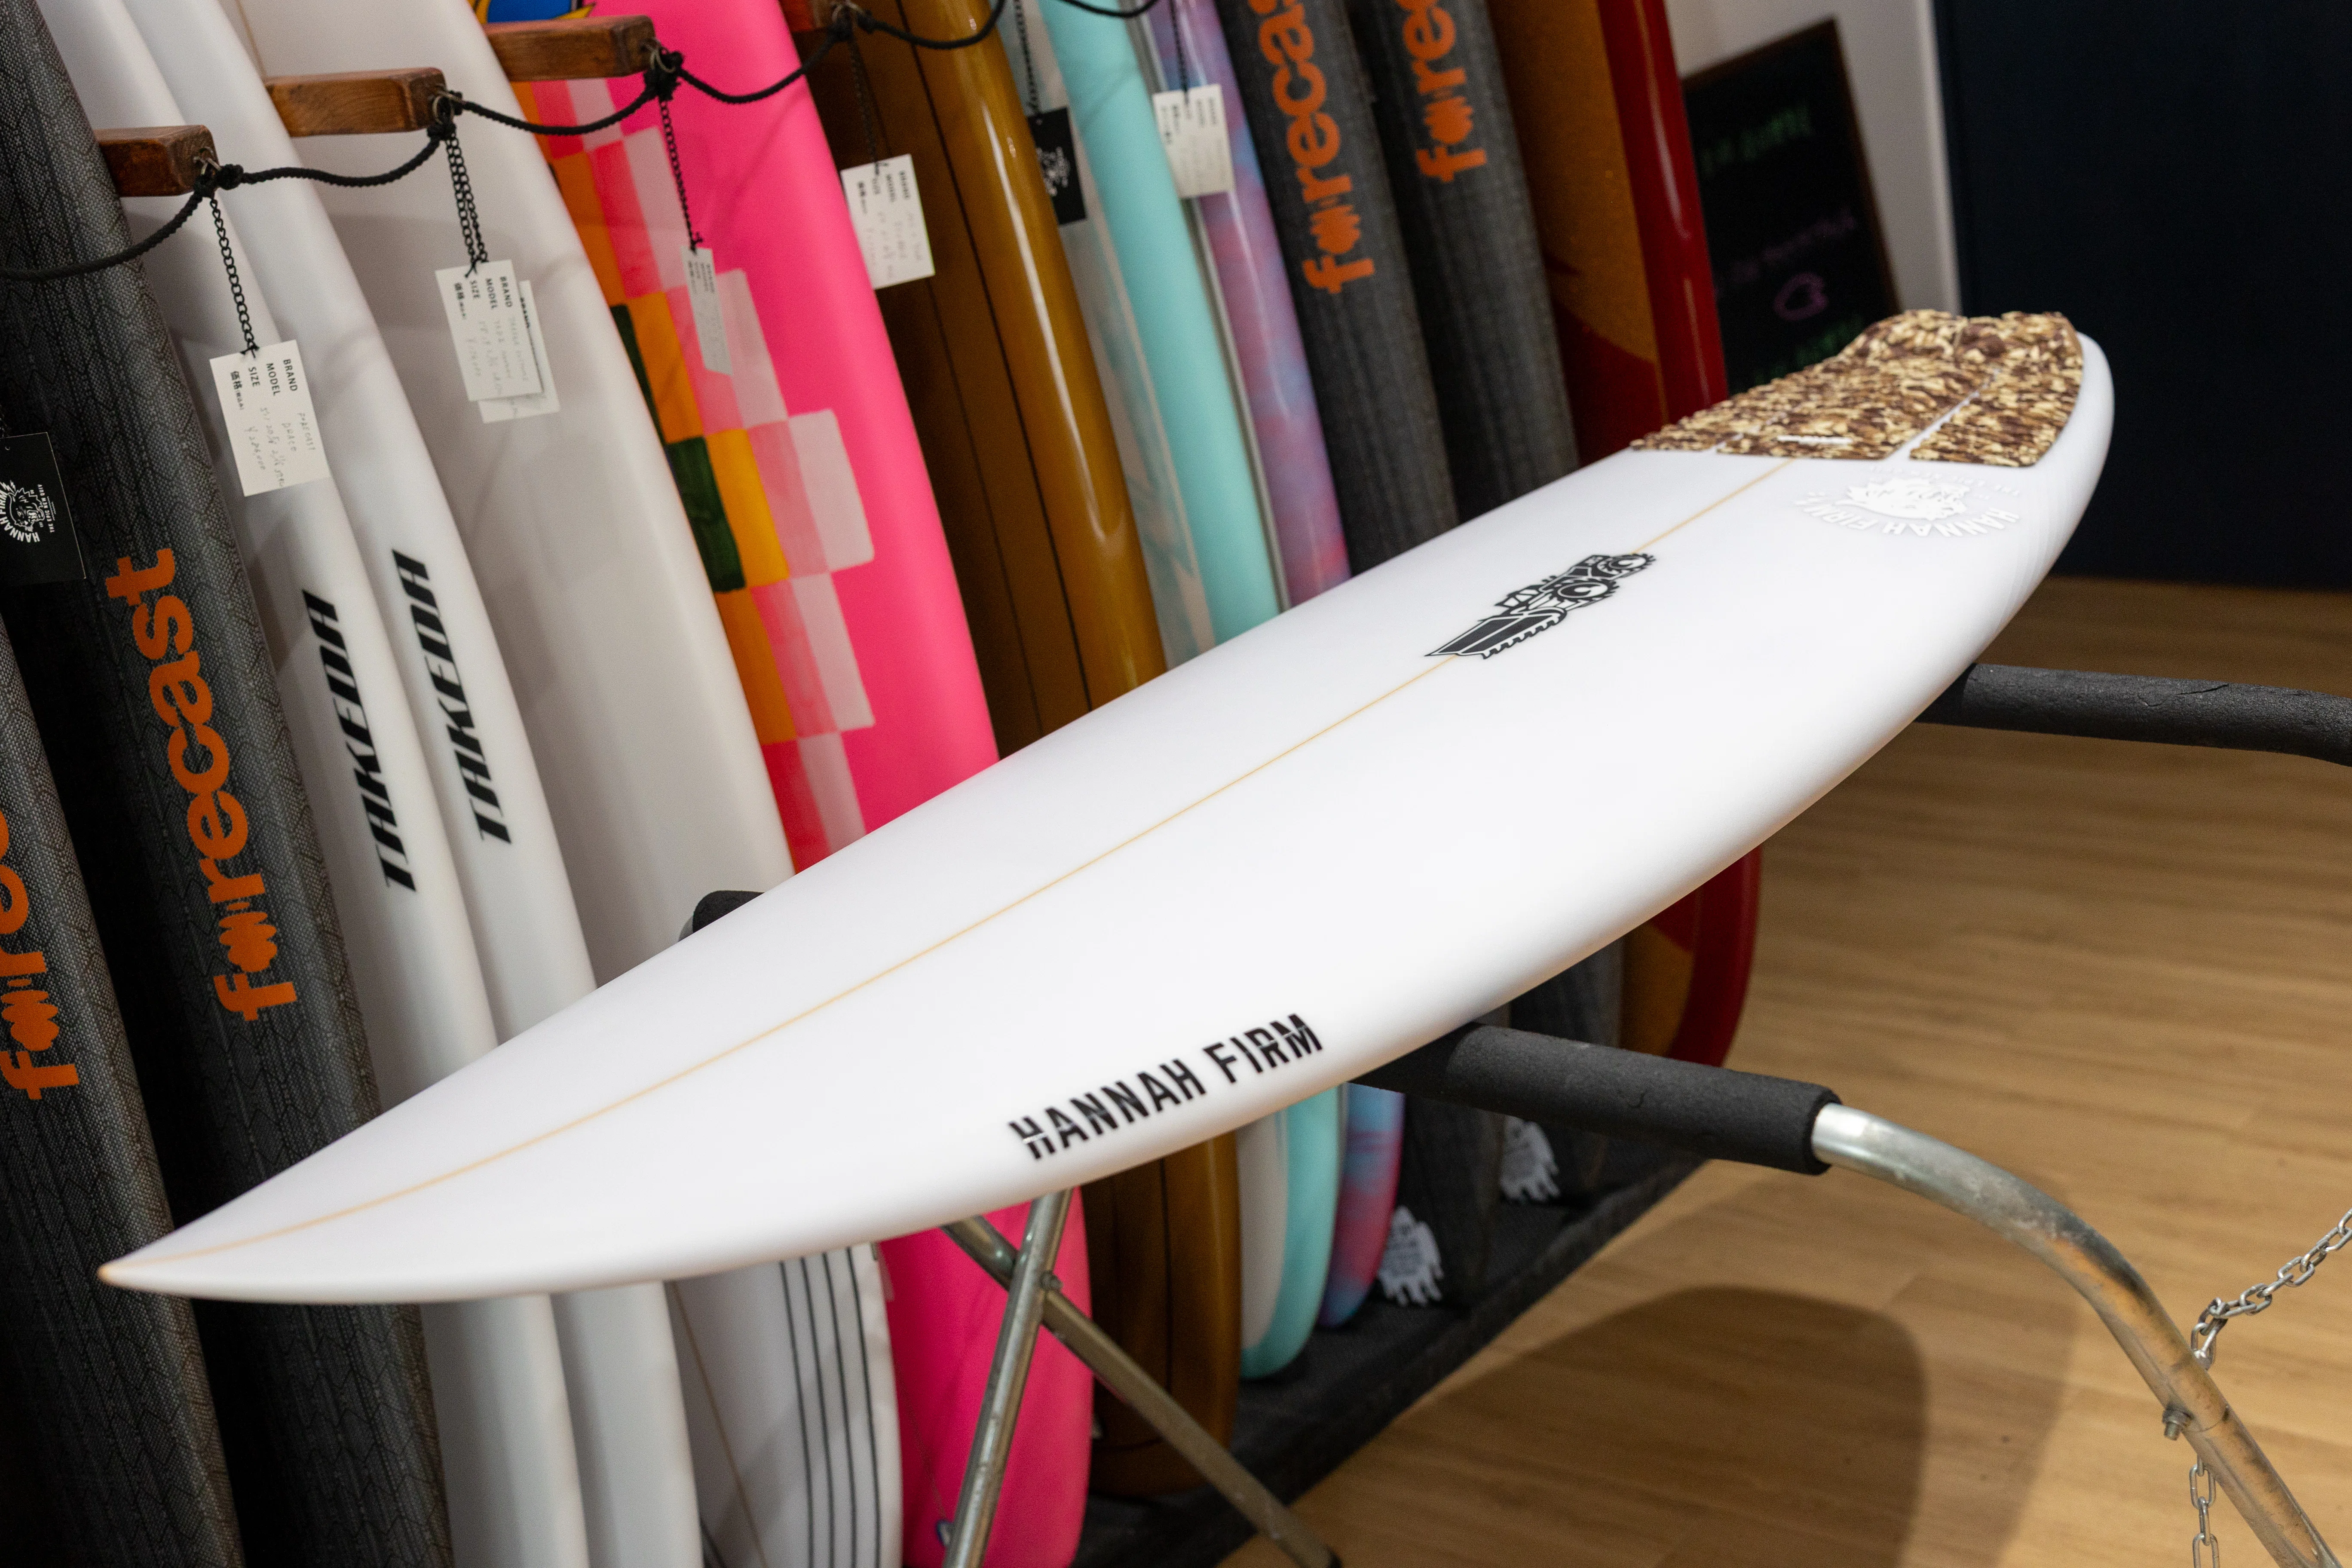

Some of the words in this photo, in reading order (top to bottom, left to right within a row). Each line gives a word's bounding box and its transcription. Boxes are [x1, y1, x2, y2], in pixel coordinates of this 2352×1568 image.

[470, 280, 480, 299] SIZE
[486, 278, 498, 309] MODEL
[500, 276, 513, 308] BRAND
[248, 366, 260, 387] SIZE
[266, 362, 281, 397] MODEL
[283, 358, 298, 392] BRAND
[0, 517, 40, 542] HANNAH
[1882, 507, 2020, 537] HANNAH
[392, 549, 512, 844] TAKEDA
[302, 589, 416, 892] TAKEDA
[1008, 1059, 1207, 1160] HANNAH
[1203, 1013, 1323, 1084] FIRM
